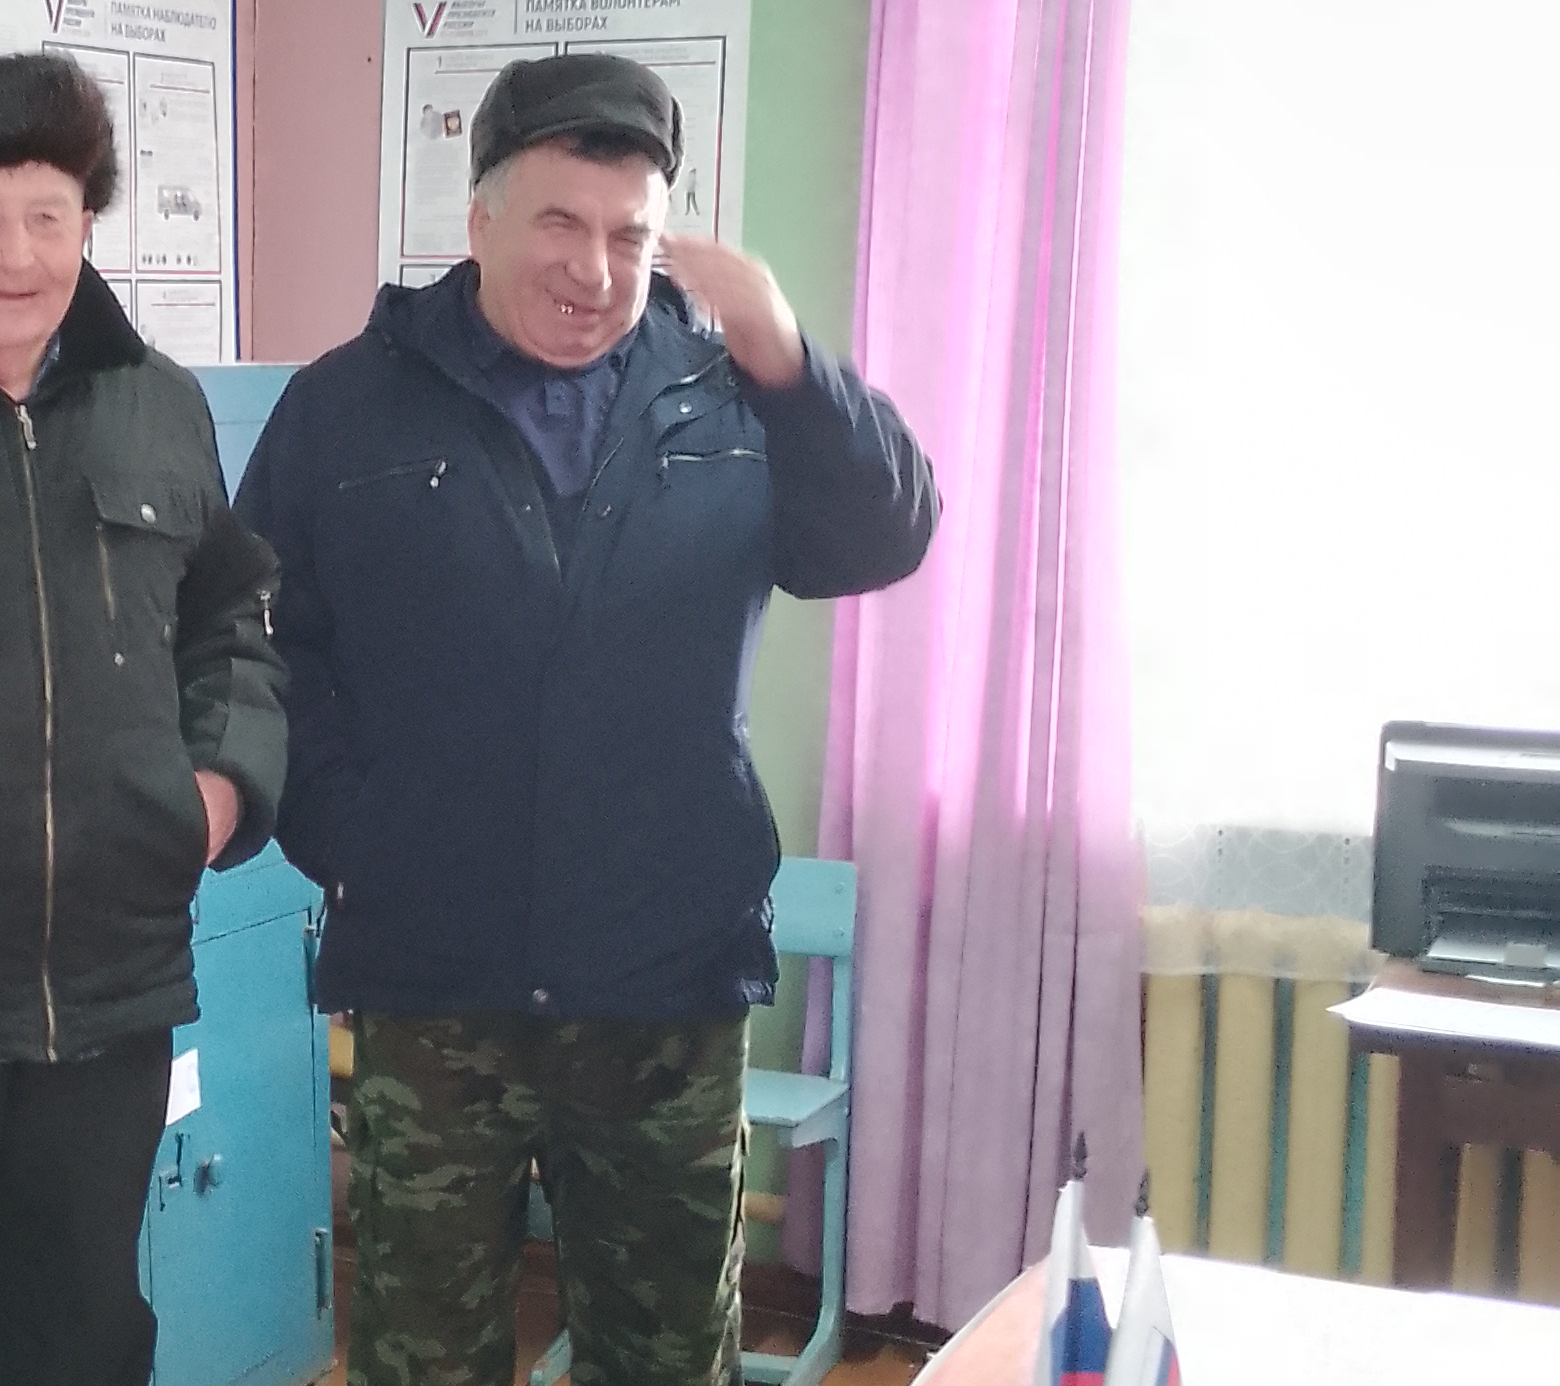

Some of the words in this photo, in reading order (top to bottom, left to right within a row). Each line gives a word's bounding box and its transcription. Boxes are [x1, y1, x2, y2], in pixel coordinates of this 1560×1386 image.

[110, 1, 151, 18] ПАМЯТКА
[111, 23, 123, 36] НА
[124, 25, 166, 42] ВЫБОРАХ
[525, 18, 541, 33] НА
[546, 15, 608, 32] ВЫБОРАХ
